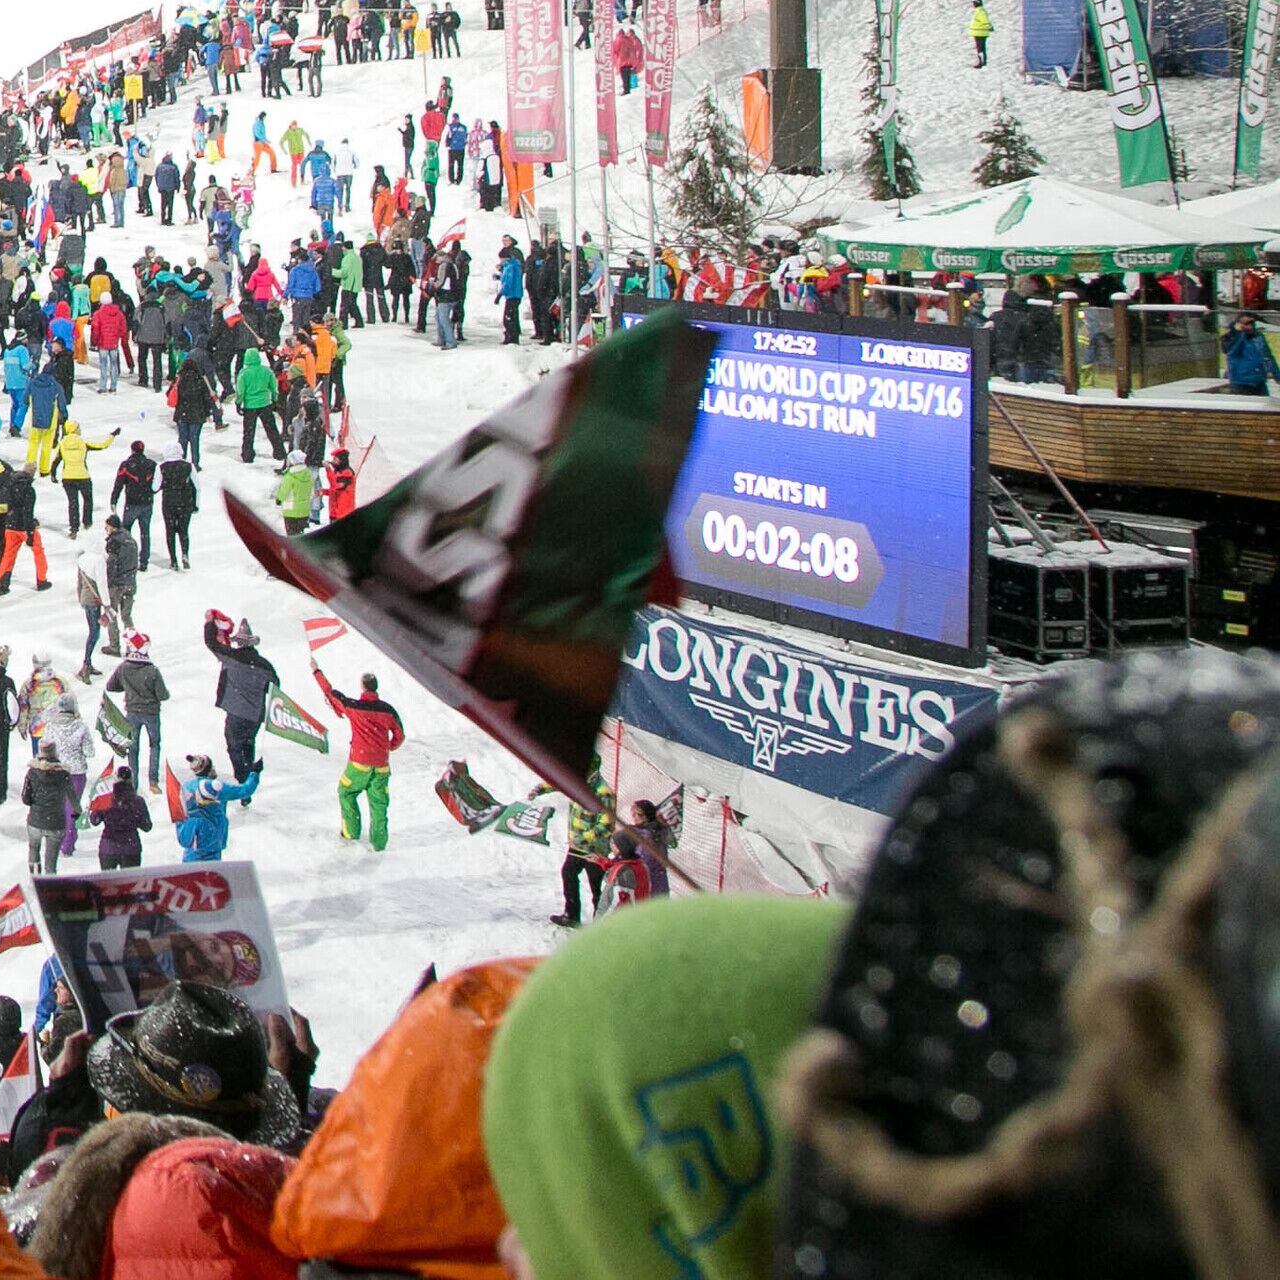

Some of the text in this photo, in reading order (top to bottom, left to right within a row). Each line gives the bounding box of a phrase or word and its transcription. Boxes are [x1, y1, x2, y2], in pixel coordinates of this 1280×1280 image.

[846, 242, 891, 266] Gösser
[931, 247, 978, 269] Gösser
[1001, 249, 1058, 270] Gösser
[1113, 247, 1173, 271] Gösser
[753, 331, 817, 357] 17:42:52
[860, 341, 970, 372] LONGINES
[739, 359, 817, 399] WORLD
[819, 370, 868, 405] CUP
[868, 376, 965, 418] 2015/16
[781, 401, 822, 430] 1ST
[823, 406, 877, 438] RUN
[733, 471, 827, 509] STARTS IN
[701, 509, 860, 584] 00:02:08
